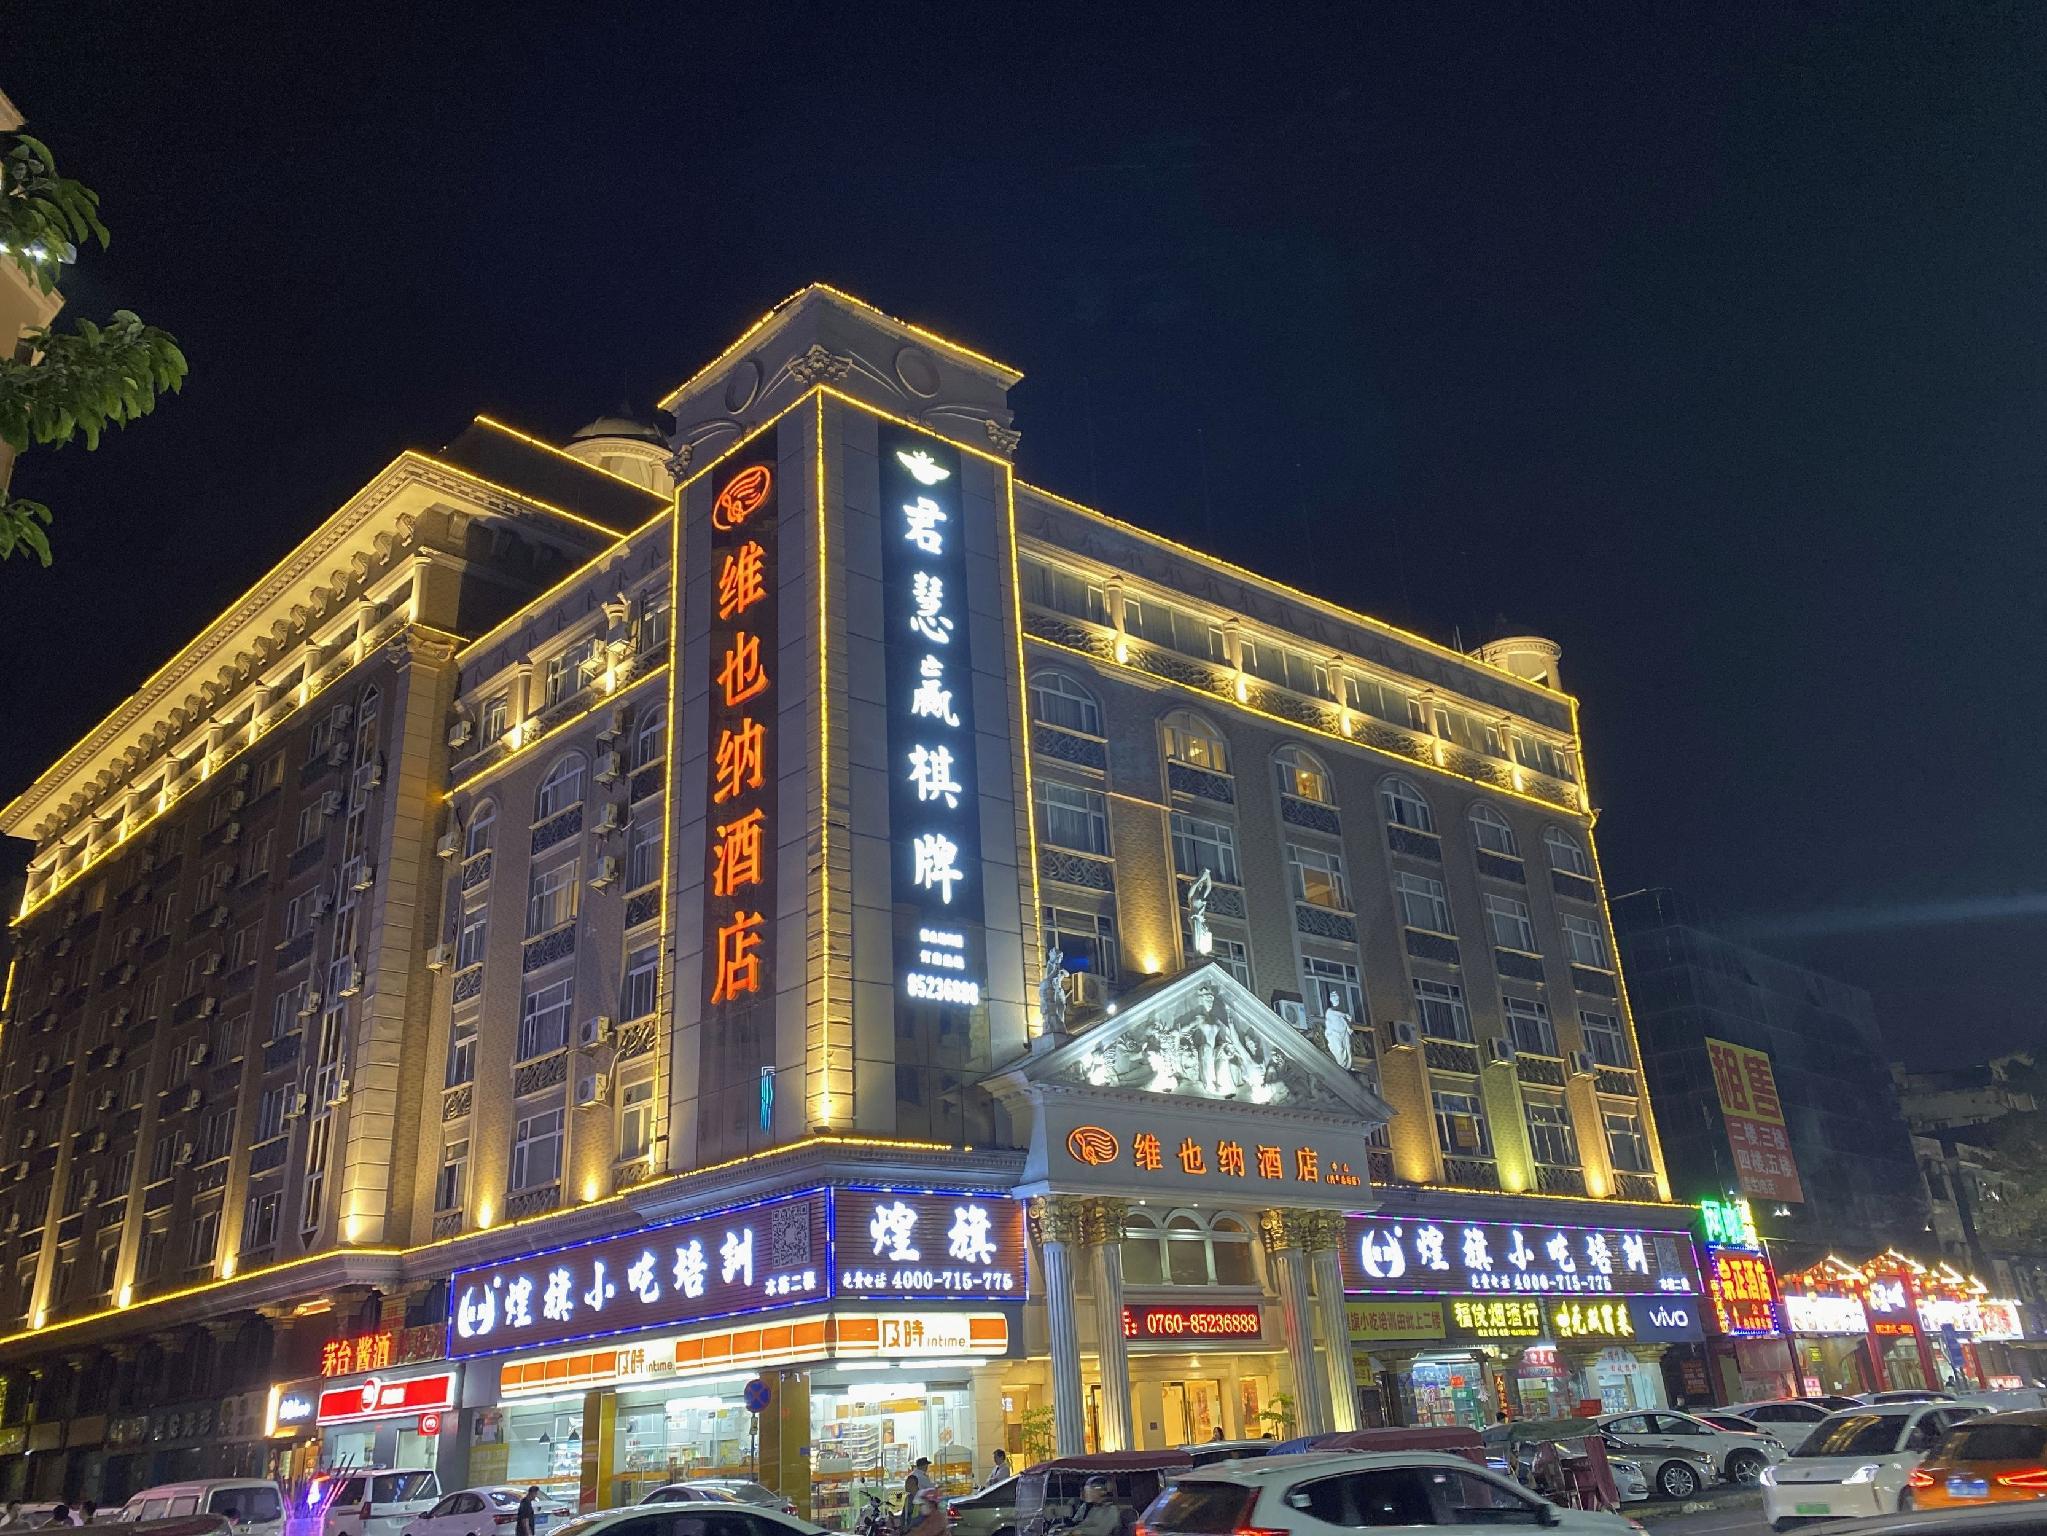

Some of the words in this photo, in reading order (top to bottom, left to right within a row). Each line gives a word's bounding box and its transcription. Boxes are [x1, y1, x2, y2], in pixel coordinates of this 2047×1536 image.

[710, 540, 770, 1006] 维也纳酒店
[1133, 1132, 1320, 1184] 维也纳酒店
[870, 1201, 997, 1265] 煌旗
[1416, 1224, 1650, 1277] 煌旗小吃培训
[504, 1227, 753, 1329] 煌旗小吃培训
[892, 1271, 1014, 1291] 4000-715-775
[927, 1333, 966, 1348] intime
[1147, 1313, 1258, 1334] 0760-85236888
[1649, 1306, 1689, 1328] vivo
